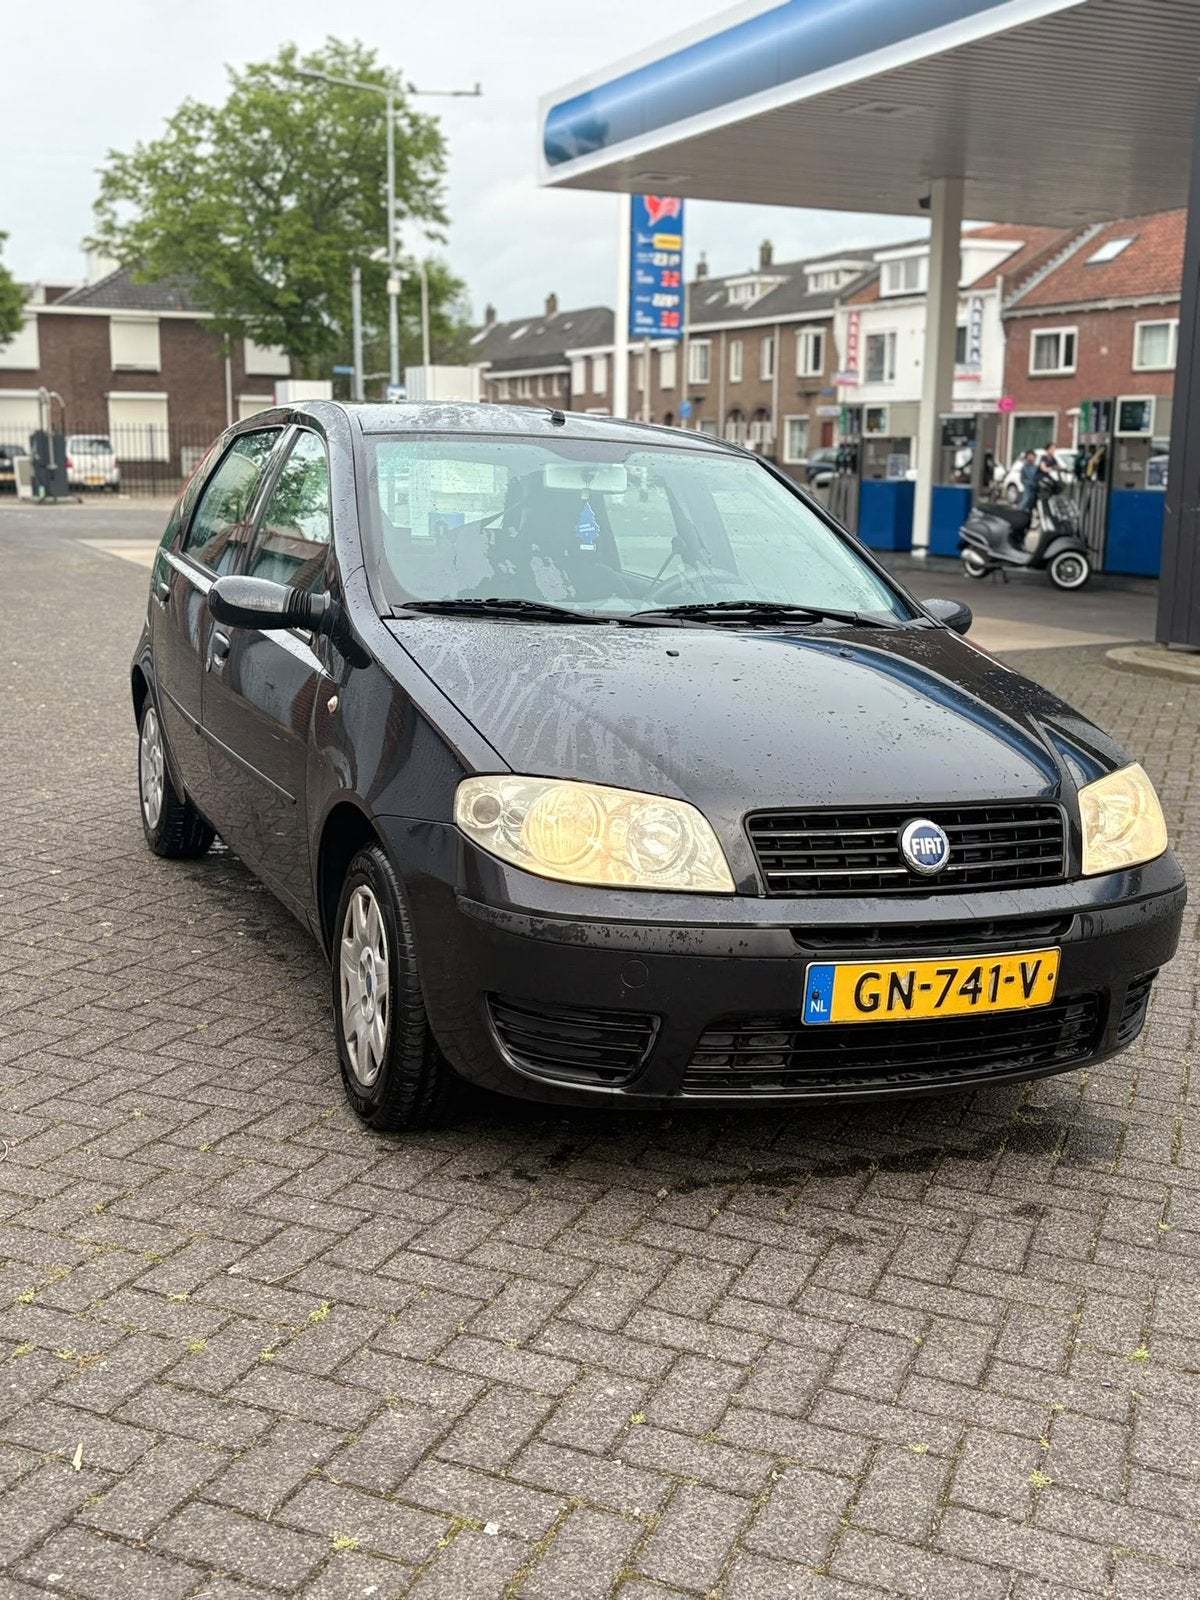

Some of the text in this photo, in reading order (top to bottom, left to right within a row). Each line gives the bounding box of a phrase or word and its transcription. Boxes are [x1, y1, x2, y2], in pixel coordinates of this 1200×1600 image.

[911, 837, 942, 855] FIAT
[853, 959, 1042, 1013] GN-741-V
[810, 1000, 828, 1013] NL
